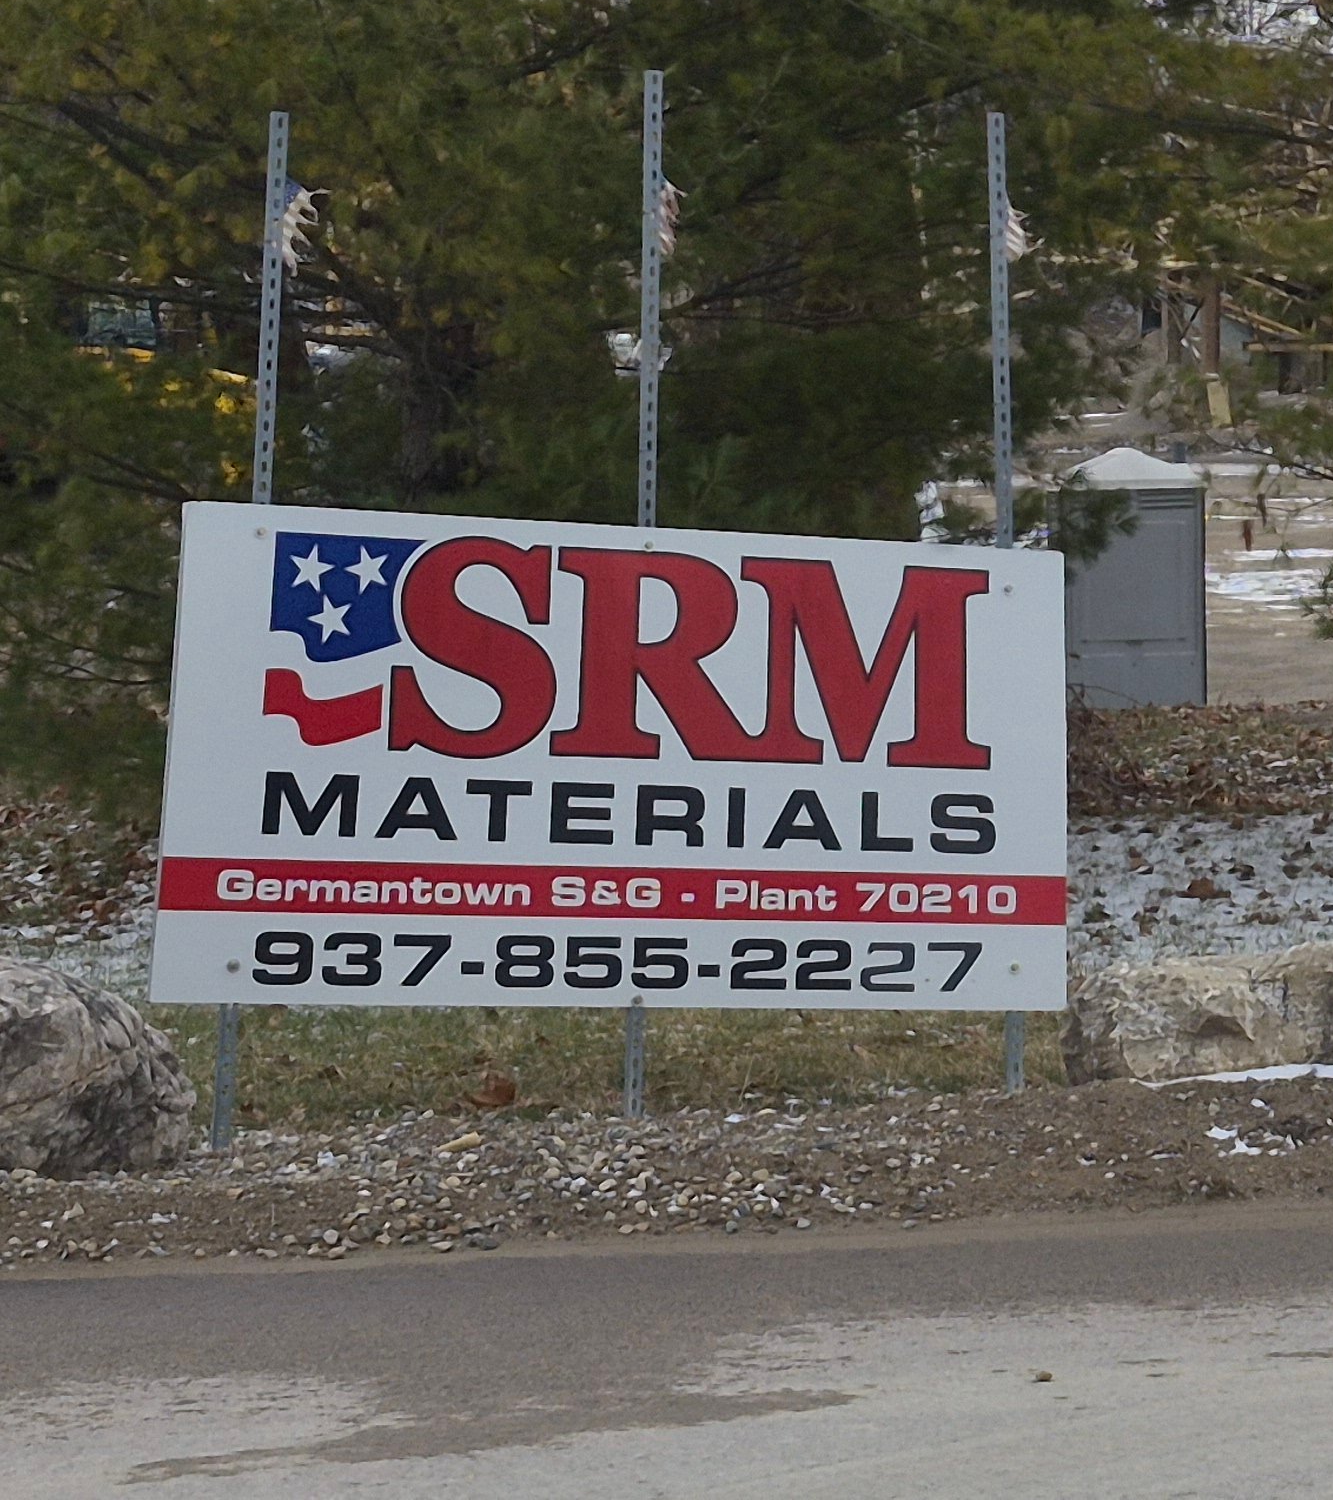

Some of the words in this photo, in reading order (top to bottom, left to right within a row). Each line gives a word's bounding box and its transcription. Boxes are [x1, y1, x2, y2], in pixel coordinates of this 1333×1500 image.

[387, 535, 992, 770] SRM
[260, 771, 997, 855] MATERIALS
[216, 867, 531, 907] Germantown
[550, 876, 661, 910] S&G
[715, 878, 837, 913] Plant
[857, 882, 1017, 916] 70210
[252, 930, 984, 994] 937-855-2227
